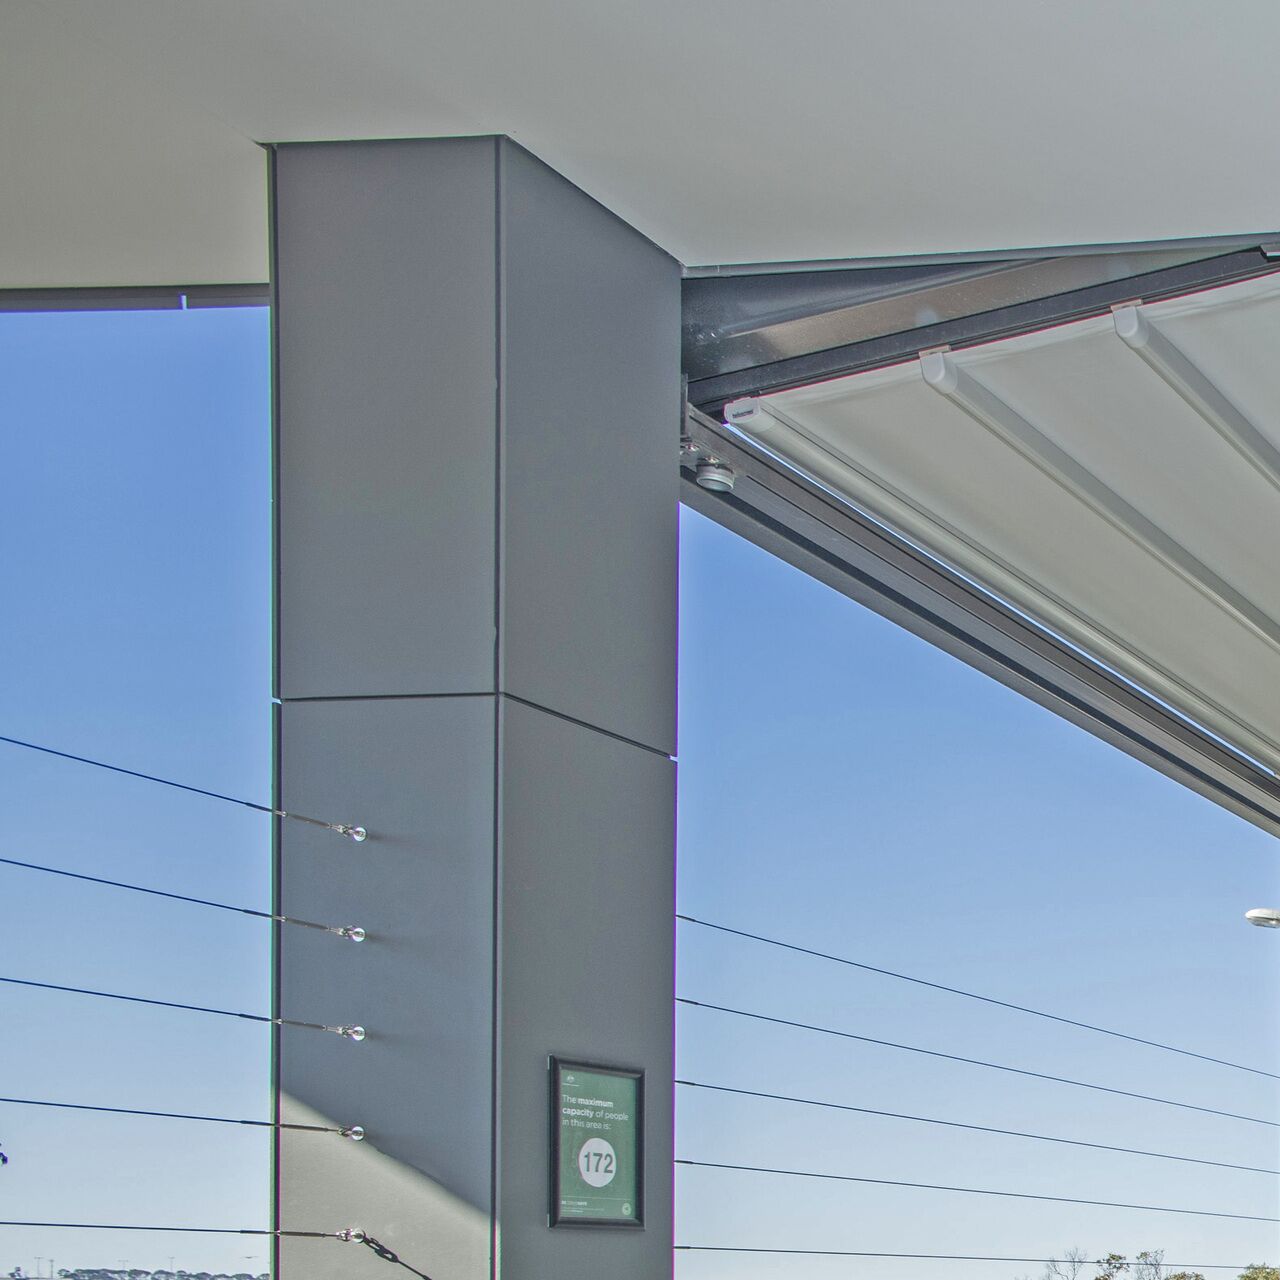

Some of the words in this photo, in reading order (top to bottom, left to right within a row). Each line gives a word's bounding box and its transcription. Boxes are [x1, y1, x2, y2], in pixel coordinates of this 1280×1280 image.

[562, 1094, 577, 1104] The
[577, 1098, 614, 1108] maximum
[562, 1107, 594, 1118] capacity
[595, 1109, 604, 1118] of
[604, 1112, 629, 1121] people
[562, 1118, 570, 1126] in
[570, 1118, 585, 1128] this
[586, 1121, 602, 1129] area
[584, 1152, 613, 1173] 172
